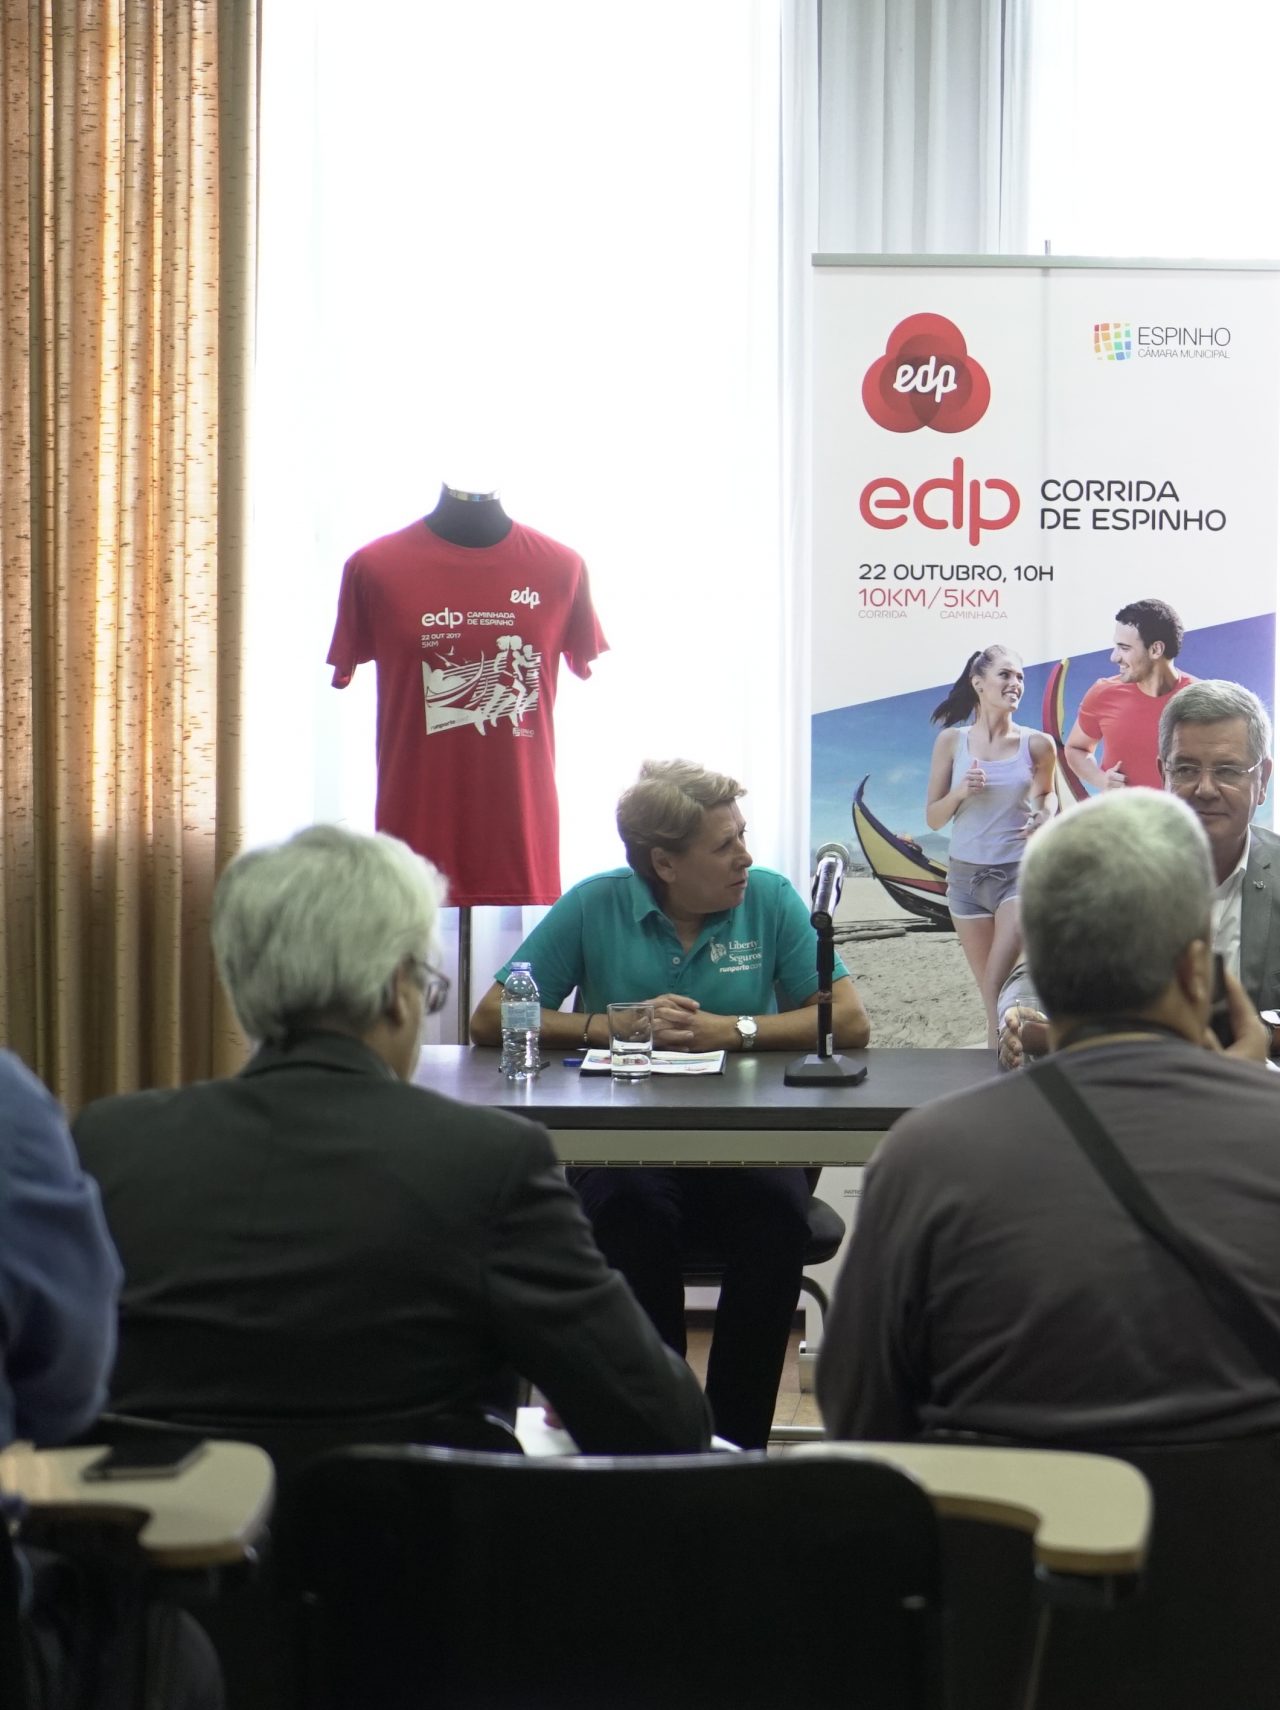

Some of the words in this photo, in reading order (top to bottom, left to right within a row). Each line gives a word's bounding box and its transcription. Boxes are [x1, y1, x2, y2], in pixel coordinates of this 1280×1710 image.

[1138, 326, 1231, 346] ESPINHO
[1137, 346, 1178, 359] CÂMARA
[1180, 348, 1231, 359] MUNICIPAL
[893, 355, 957, 403] edp
[1040, 479, 1180, 502] CORRIDA
[859, 456, 1021, 547] edp
[1040, 508, 1081, 530] DE
[1092, 509, 1227, 532] ESPINHO
[859, 563, 887, 580] 22
[893, 564, 1007, 583] OUTUBRO,
[1014, 565, 1054, 582] 10H
[510, 587, 541, 609] edp
[421, 607, 463, 629] edp
[467, 611, 516, 619] CAMINHADA
[858, 609, 908, 619] CORRIDA
[939, 610, 1008, 620] CAMINHADA
[729, 940, 757, 951] Liberty
[729, 953, 762, 965] Seguros
